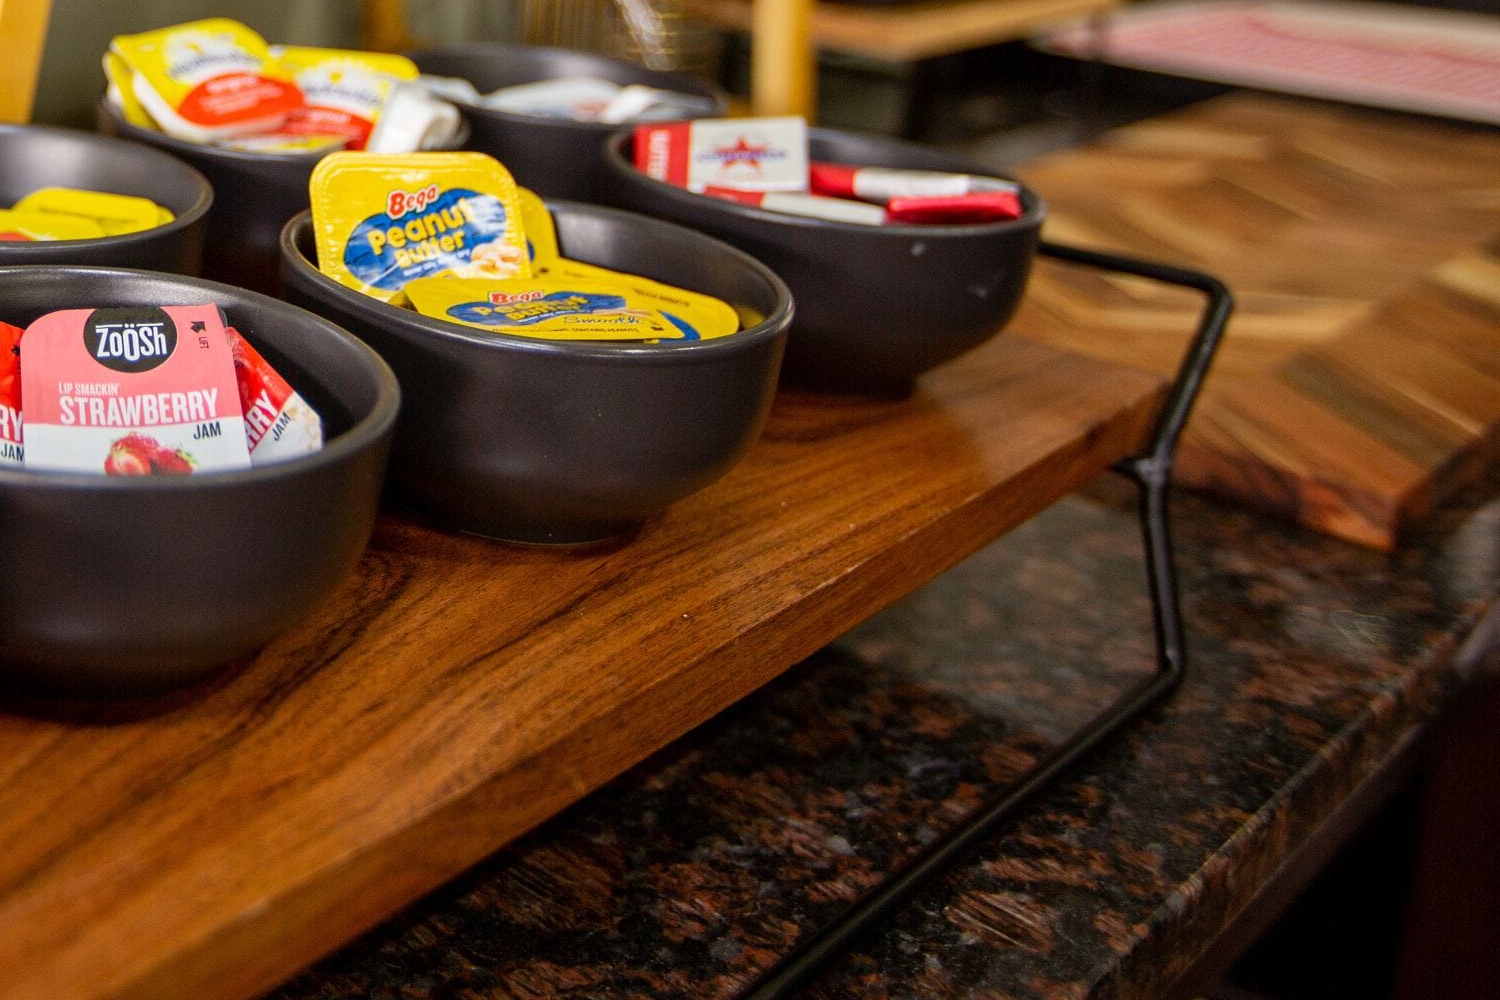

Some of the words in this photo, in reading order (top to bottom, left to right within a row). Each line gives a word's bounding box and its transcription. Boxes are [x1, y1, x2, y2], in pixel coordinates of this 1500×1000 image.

[388, 186, 438, 218] Bega
[367, 197, 474, 257] Peanut
[489, 291, 542, 304] Bega
[58, 382, 73, 394] LIP
[74, 382, 120, 396] SMACKIN'
[59, 387, 218, 427] STRAWBERRY
[193, 421, 221, 440] JAM
[271, 411, 291, 441] JAM
